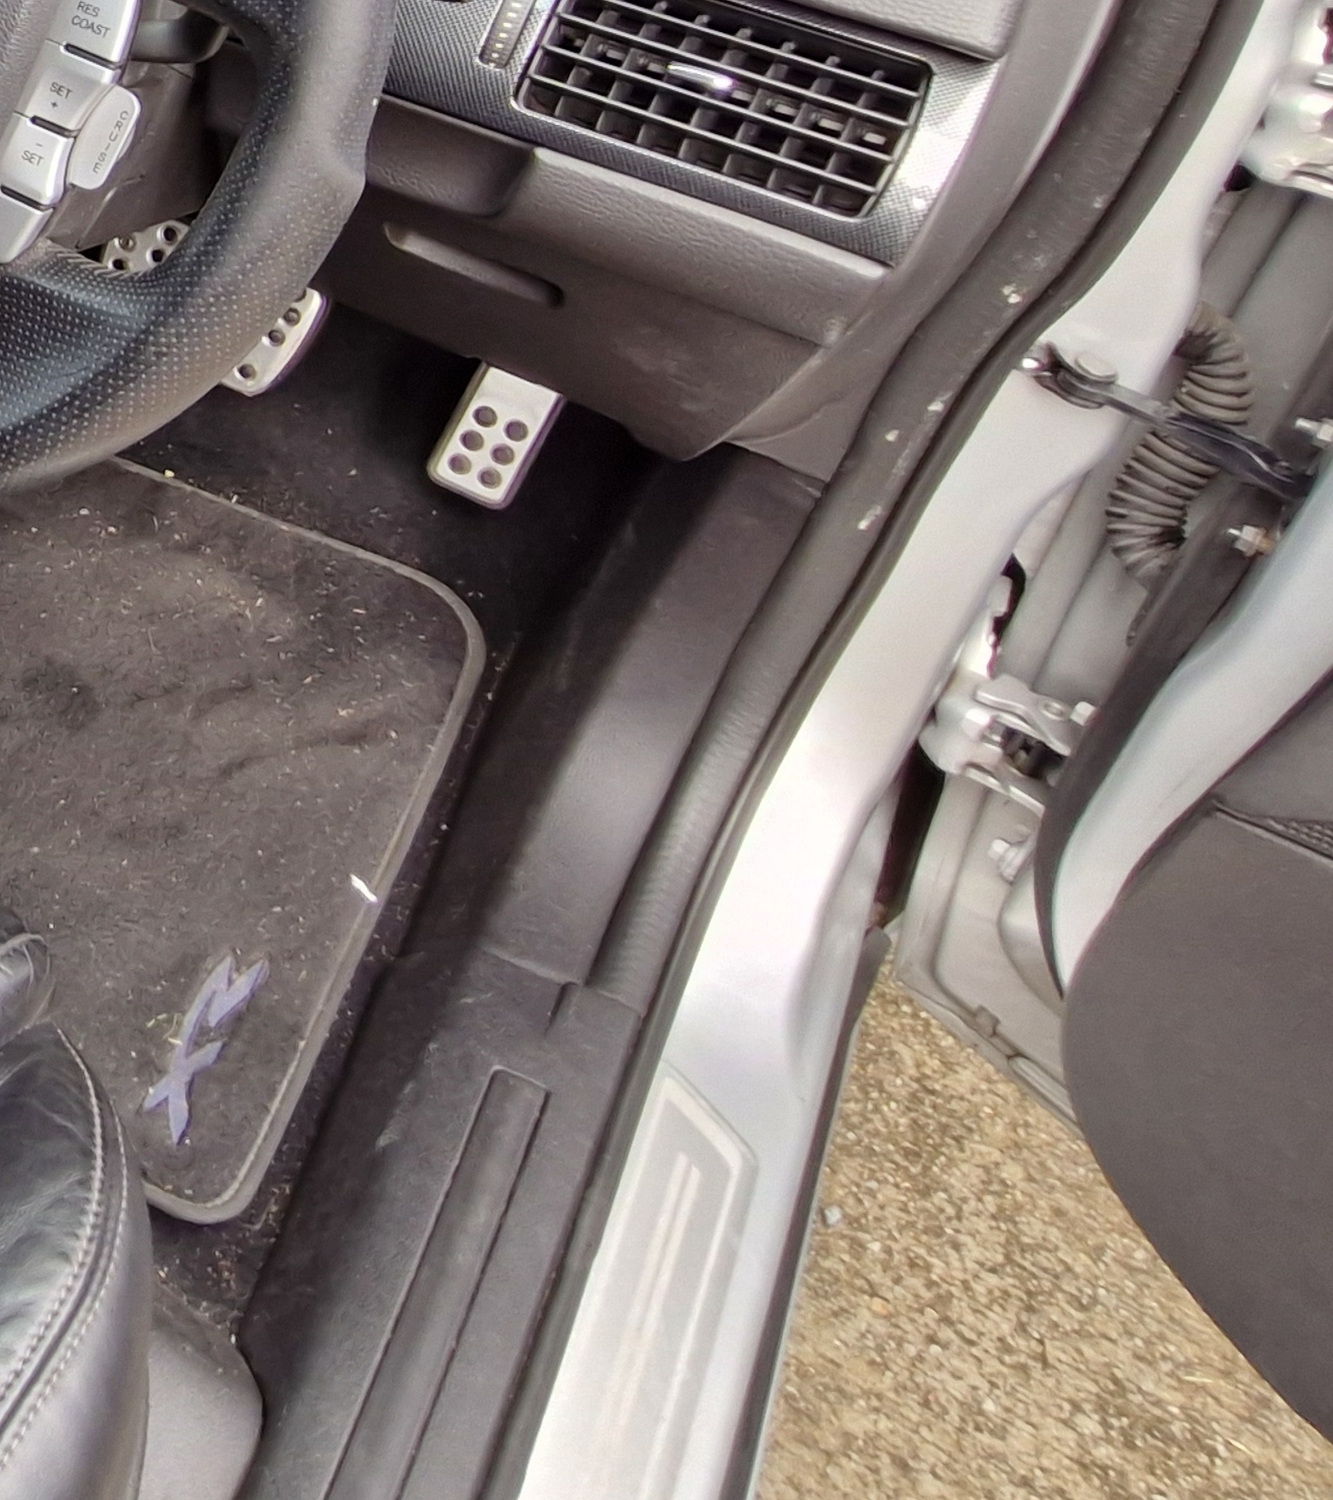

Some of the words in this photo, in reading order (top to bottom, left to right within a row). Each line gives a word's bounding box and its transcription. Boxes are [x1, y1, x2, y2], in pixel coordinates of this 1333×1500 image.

[77, 0, 100, 18] RES
[71, 15, 111, 38] COAST
[49, 81, 73, 99] SET
[93, 111, 129, 174] CRUISE
[22, 149, 44, 167] SET
